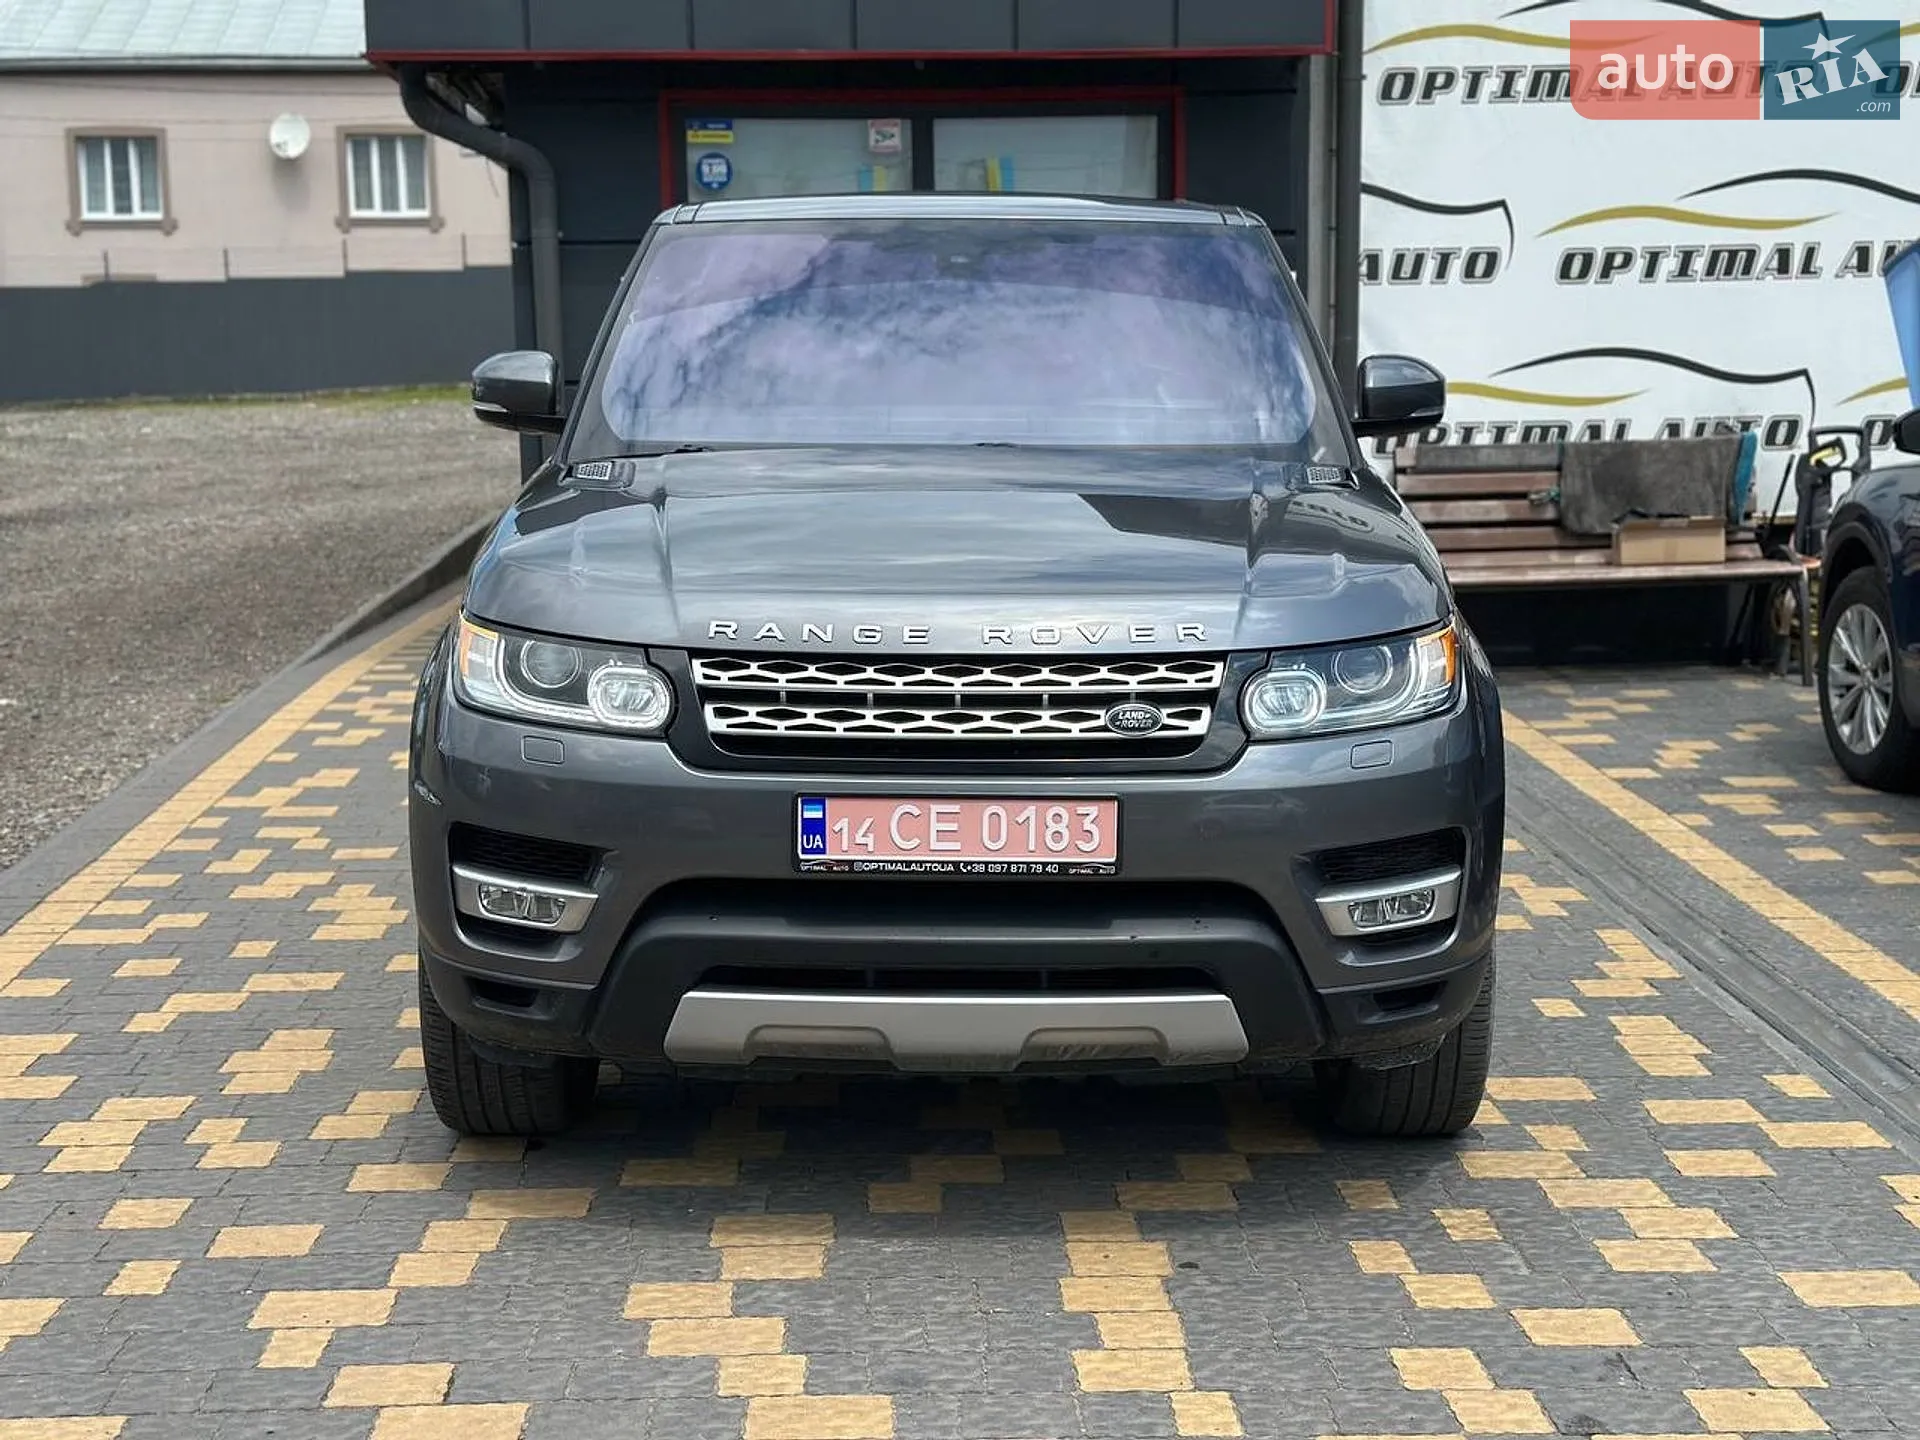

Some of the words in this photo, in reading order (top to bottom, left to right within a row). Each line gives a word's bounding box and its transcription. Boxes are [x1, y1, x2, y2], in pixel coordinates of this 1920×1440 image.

[1377, 65, 1646, 105] OPTIMAL
[1358, 247, 1503, 286] AUTO
[1554, 241, 1823, 285] OPTIMAL
[707, 620, 931, 645] RANGE
[983, 622, 1207, 645] ROVER
[1118, 711, 1145, 720] LAND
[802, 834, 824, 849] UA
[832, 817, 875, 852] 14
[889, 804, 962, 852] CE
[981, 805, 1101, 853] 0183
[1045, 863, 1060, 873] 40
